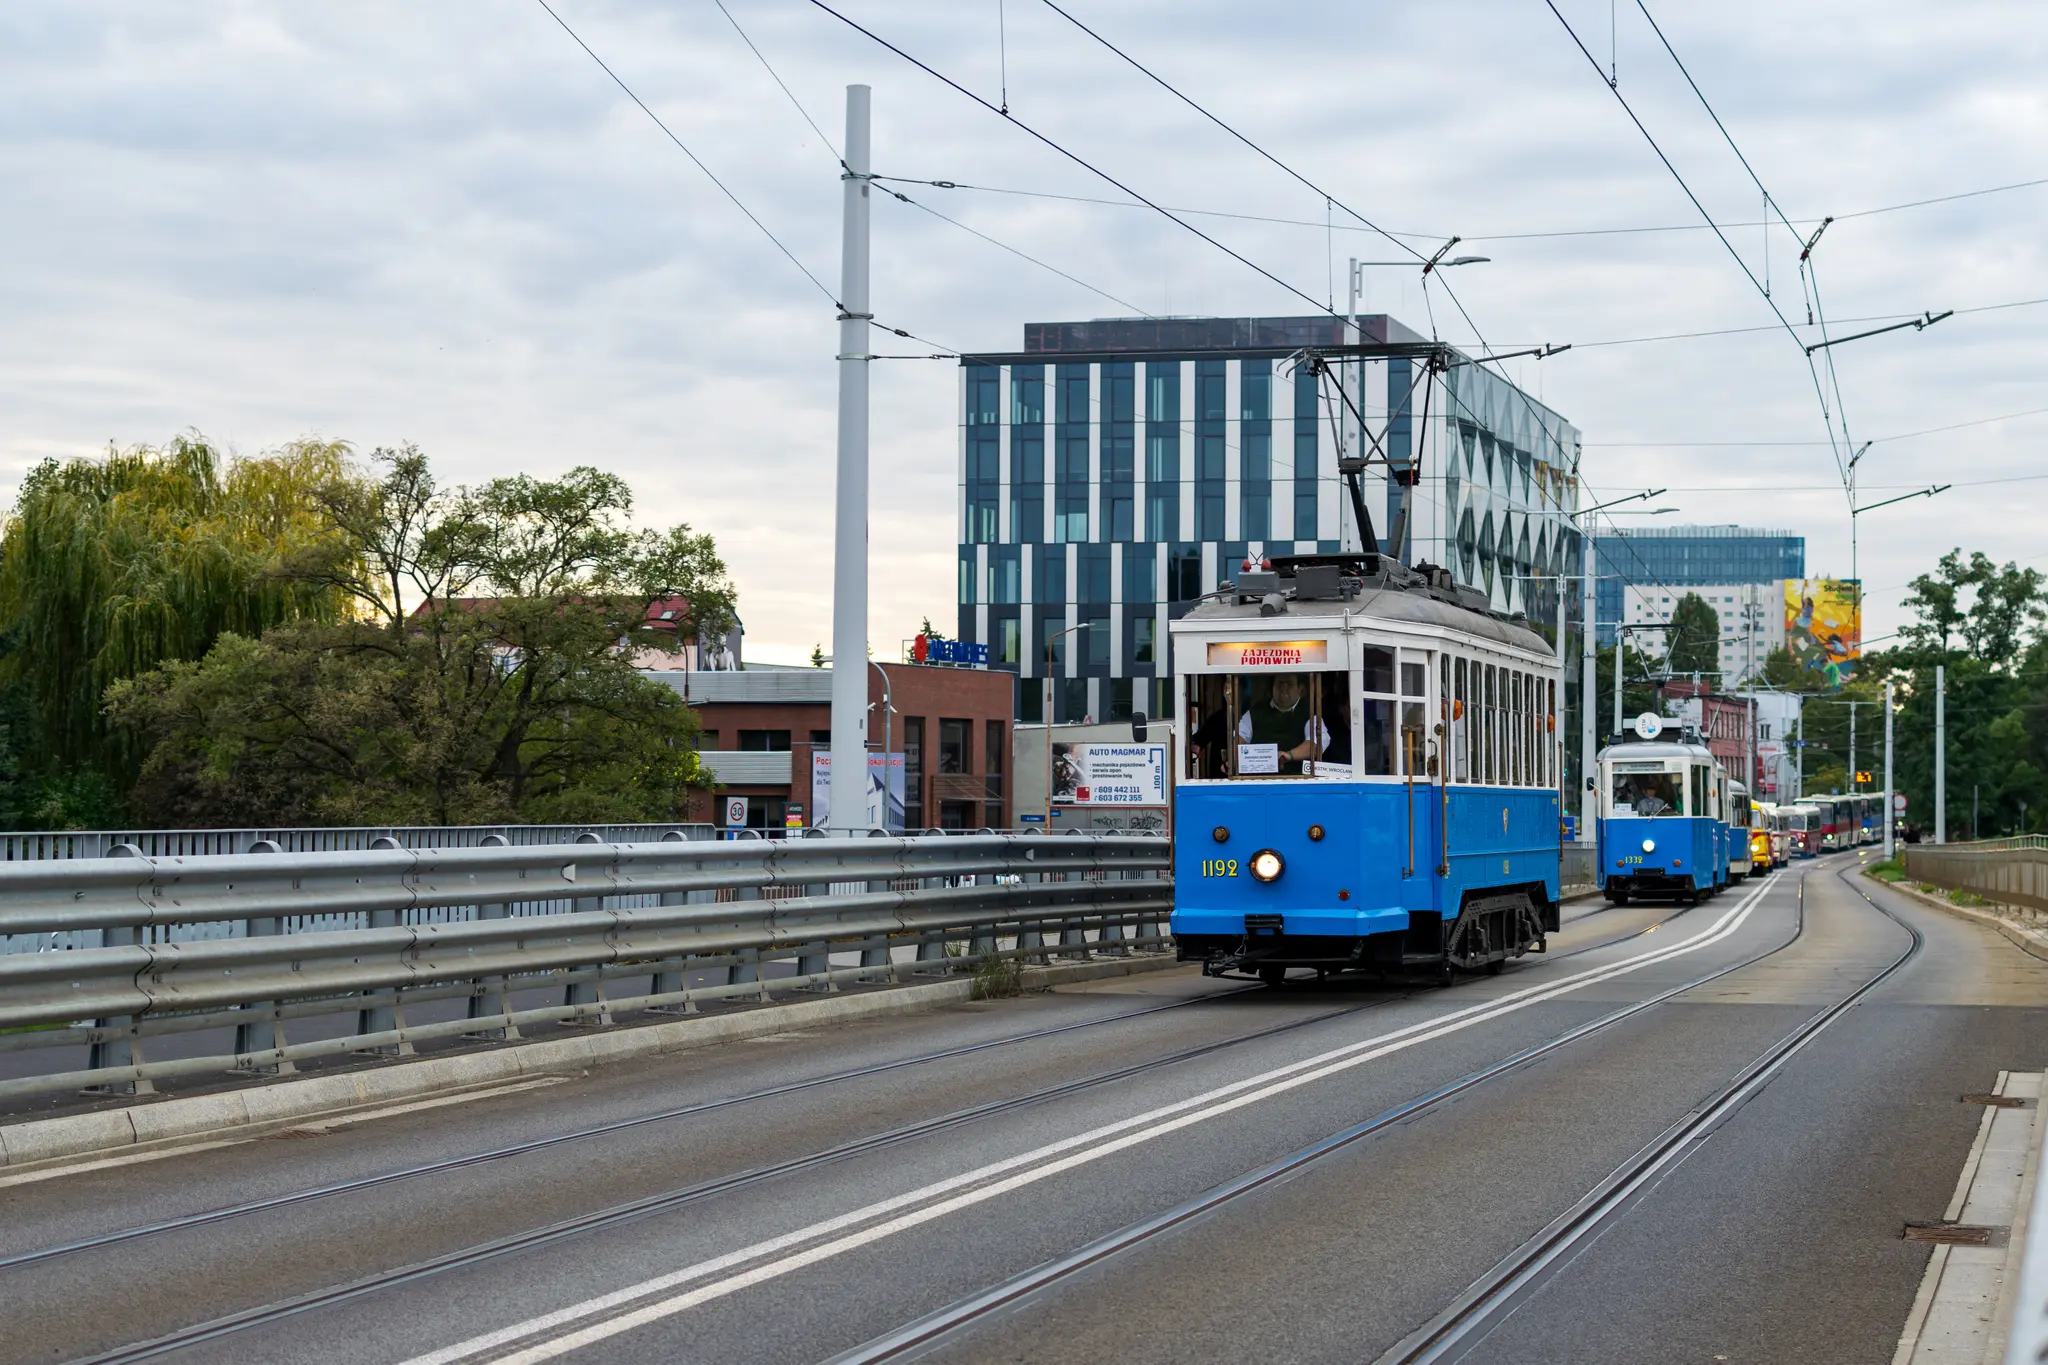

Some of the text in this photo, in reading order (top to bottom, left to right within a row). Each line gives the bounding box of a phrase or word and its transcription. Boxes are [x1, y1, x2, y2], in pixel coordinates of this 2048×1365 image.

[1242, 648, 1301, 657] ZAJEZDNIA
[1089, 748, 1146, 756] AUTO MAGMAR
[1155, 765, 1161, 773] m
[732, 807, 742, 816] 30
[1202, 859, 1239, 877] 1192
